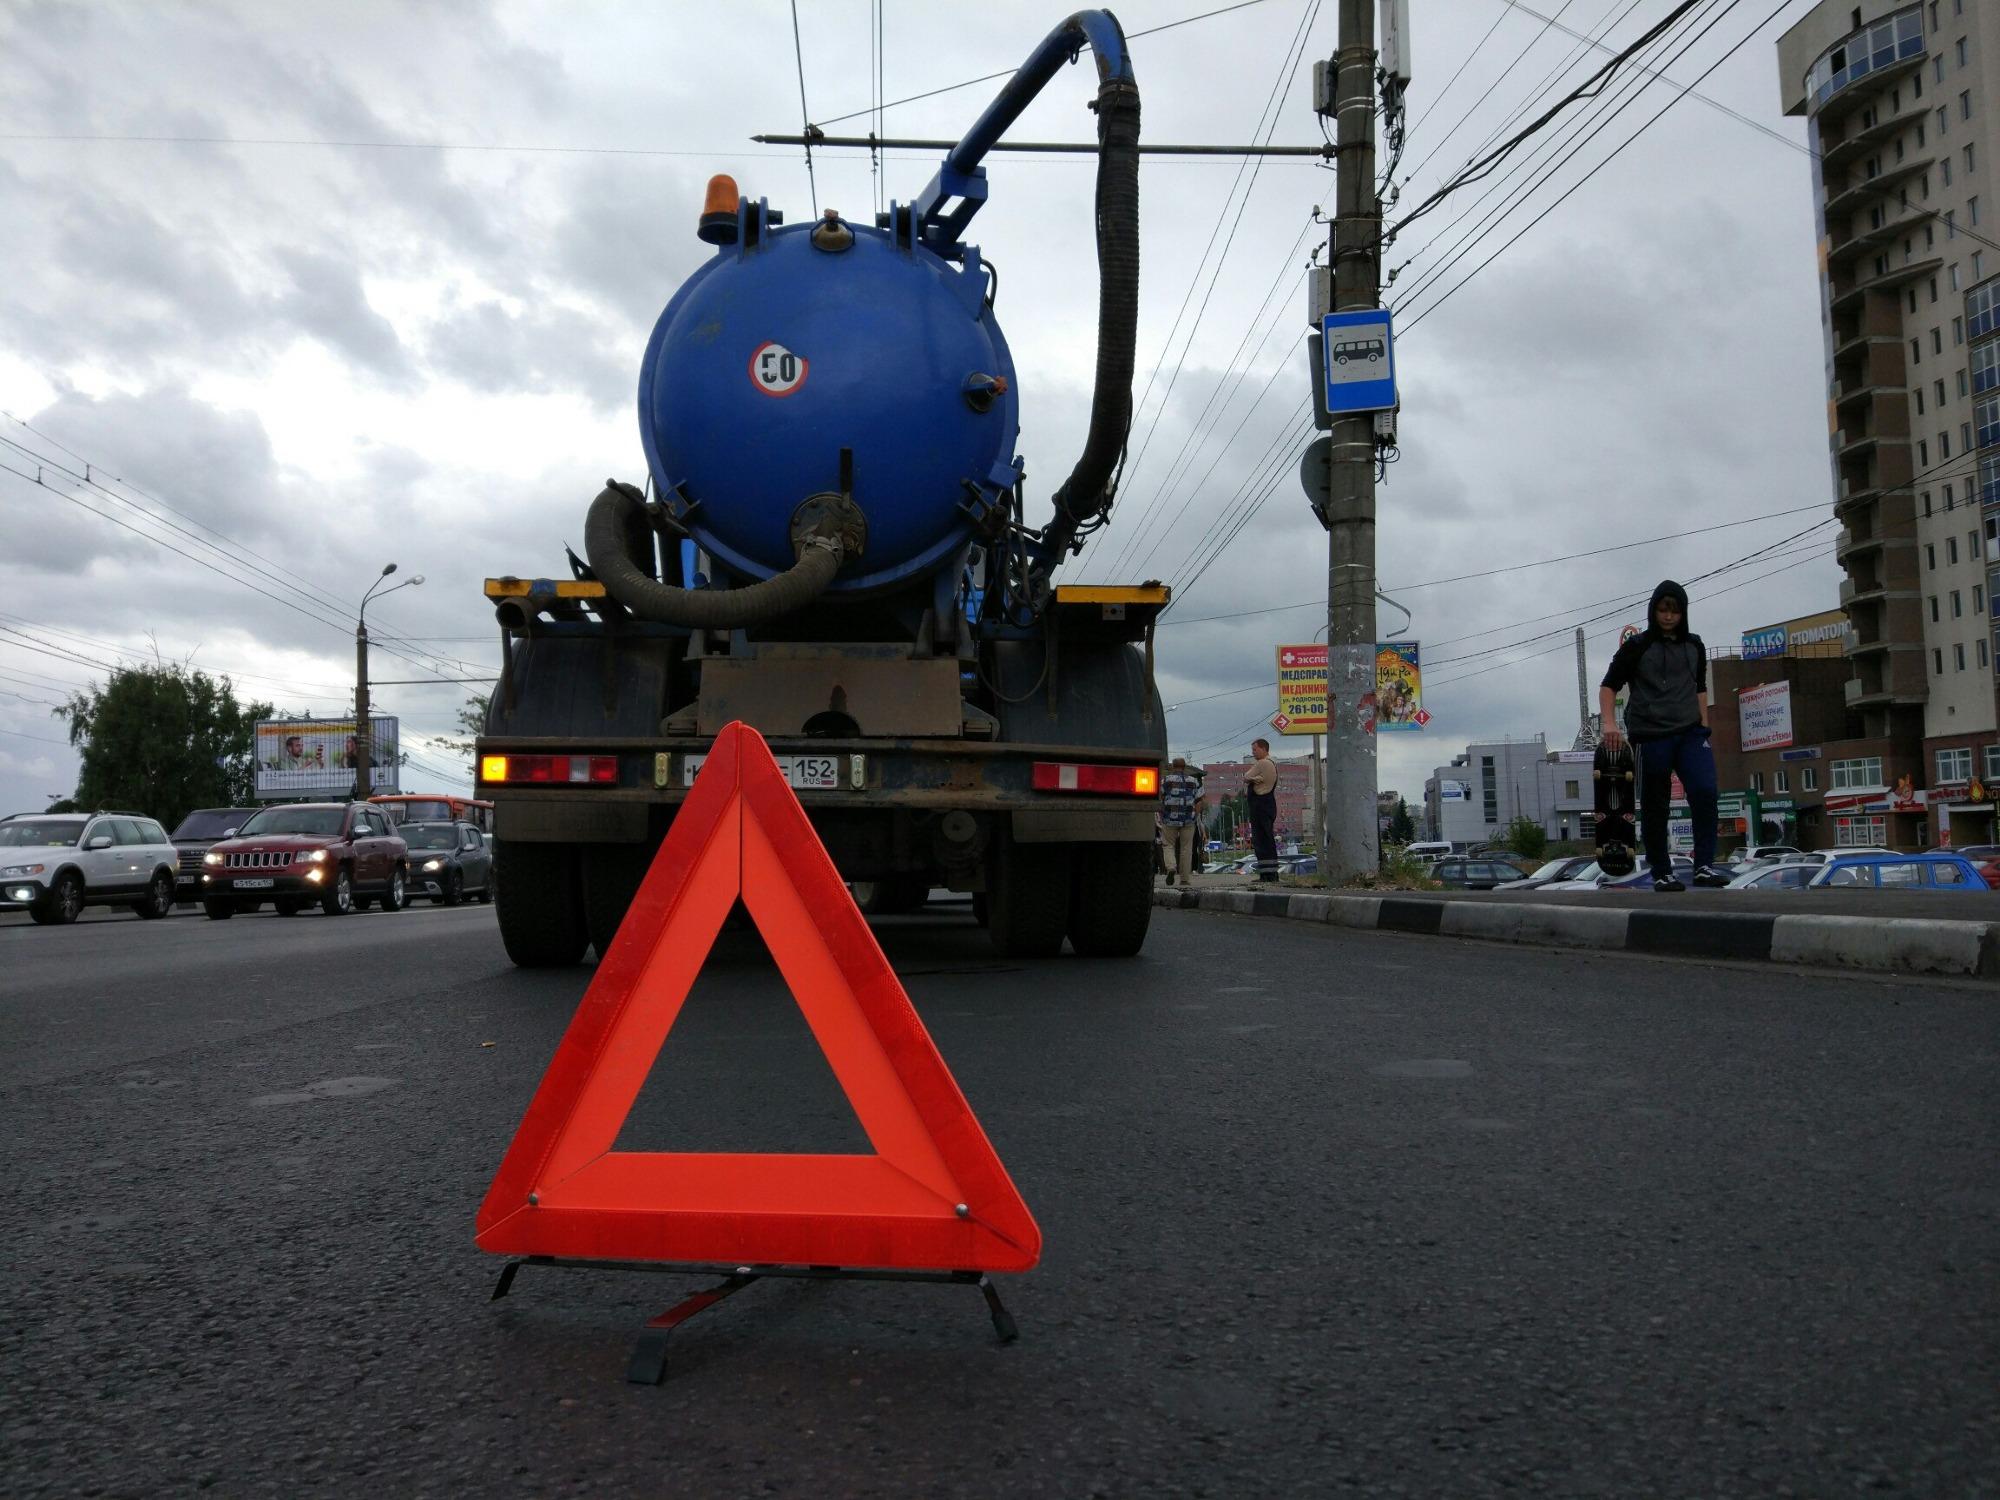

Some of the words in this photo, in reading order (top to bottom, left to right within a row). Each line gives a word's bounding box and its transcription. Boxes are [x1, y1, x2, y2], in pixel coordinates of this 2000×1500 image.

[762, 353, 796, 383] 50
[1281, 669, 1328, 681] МЕДСПРАВ
[795, 759, 831, 778] 152
